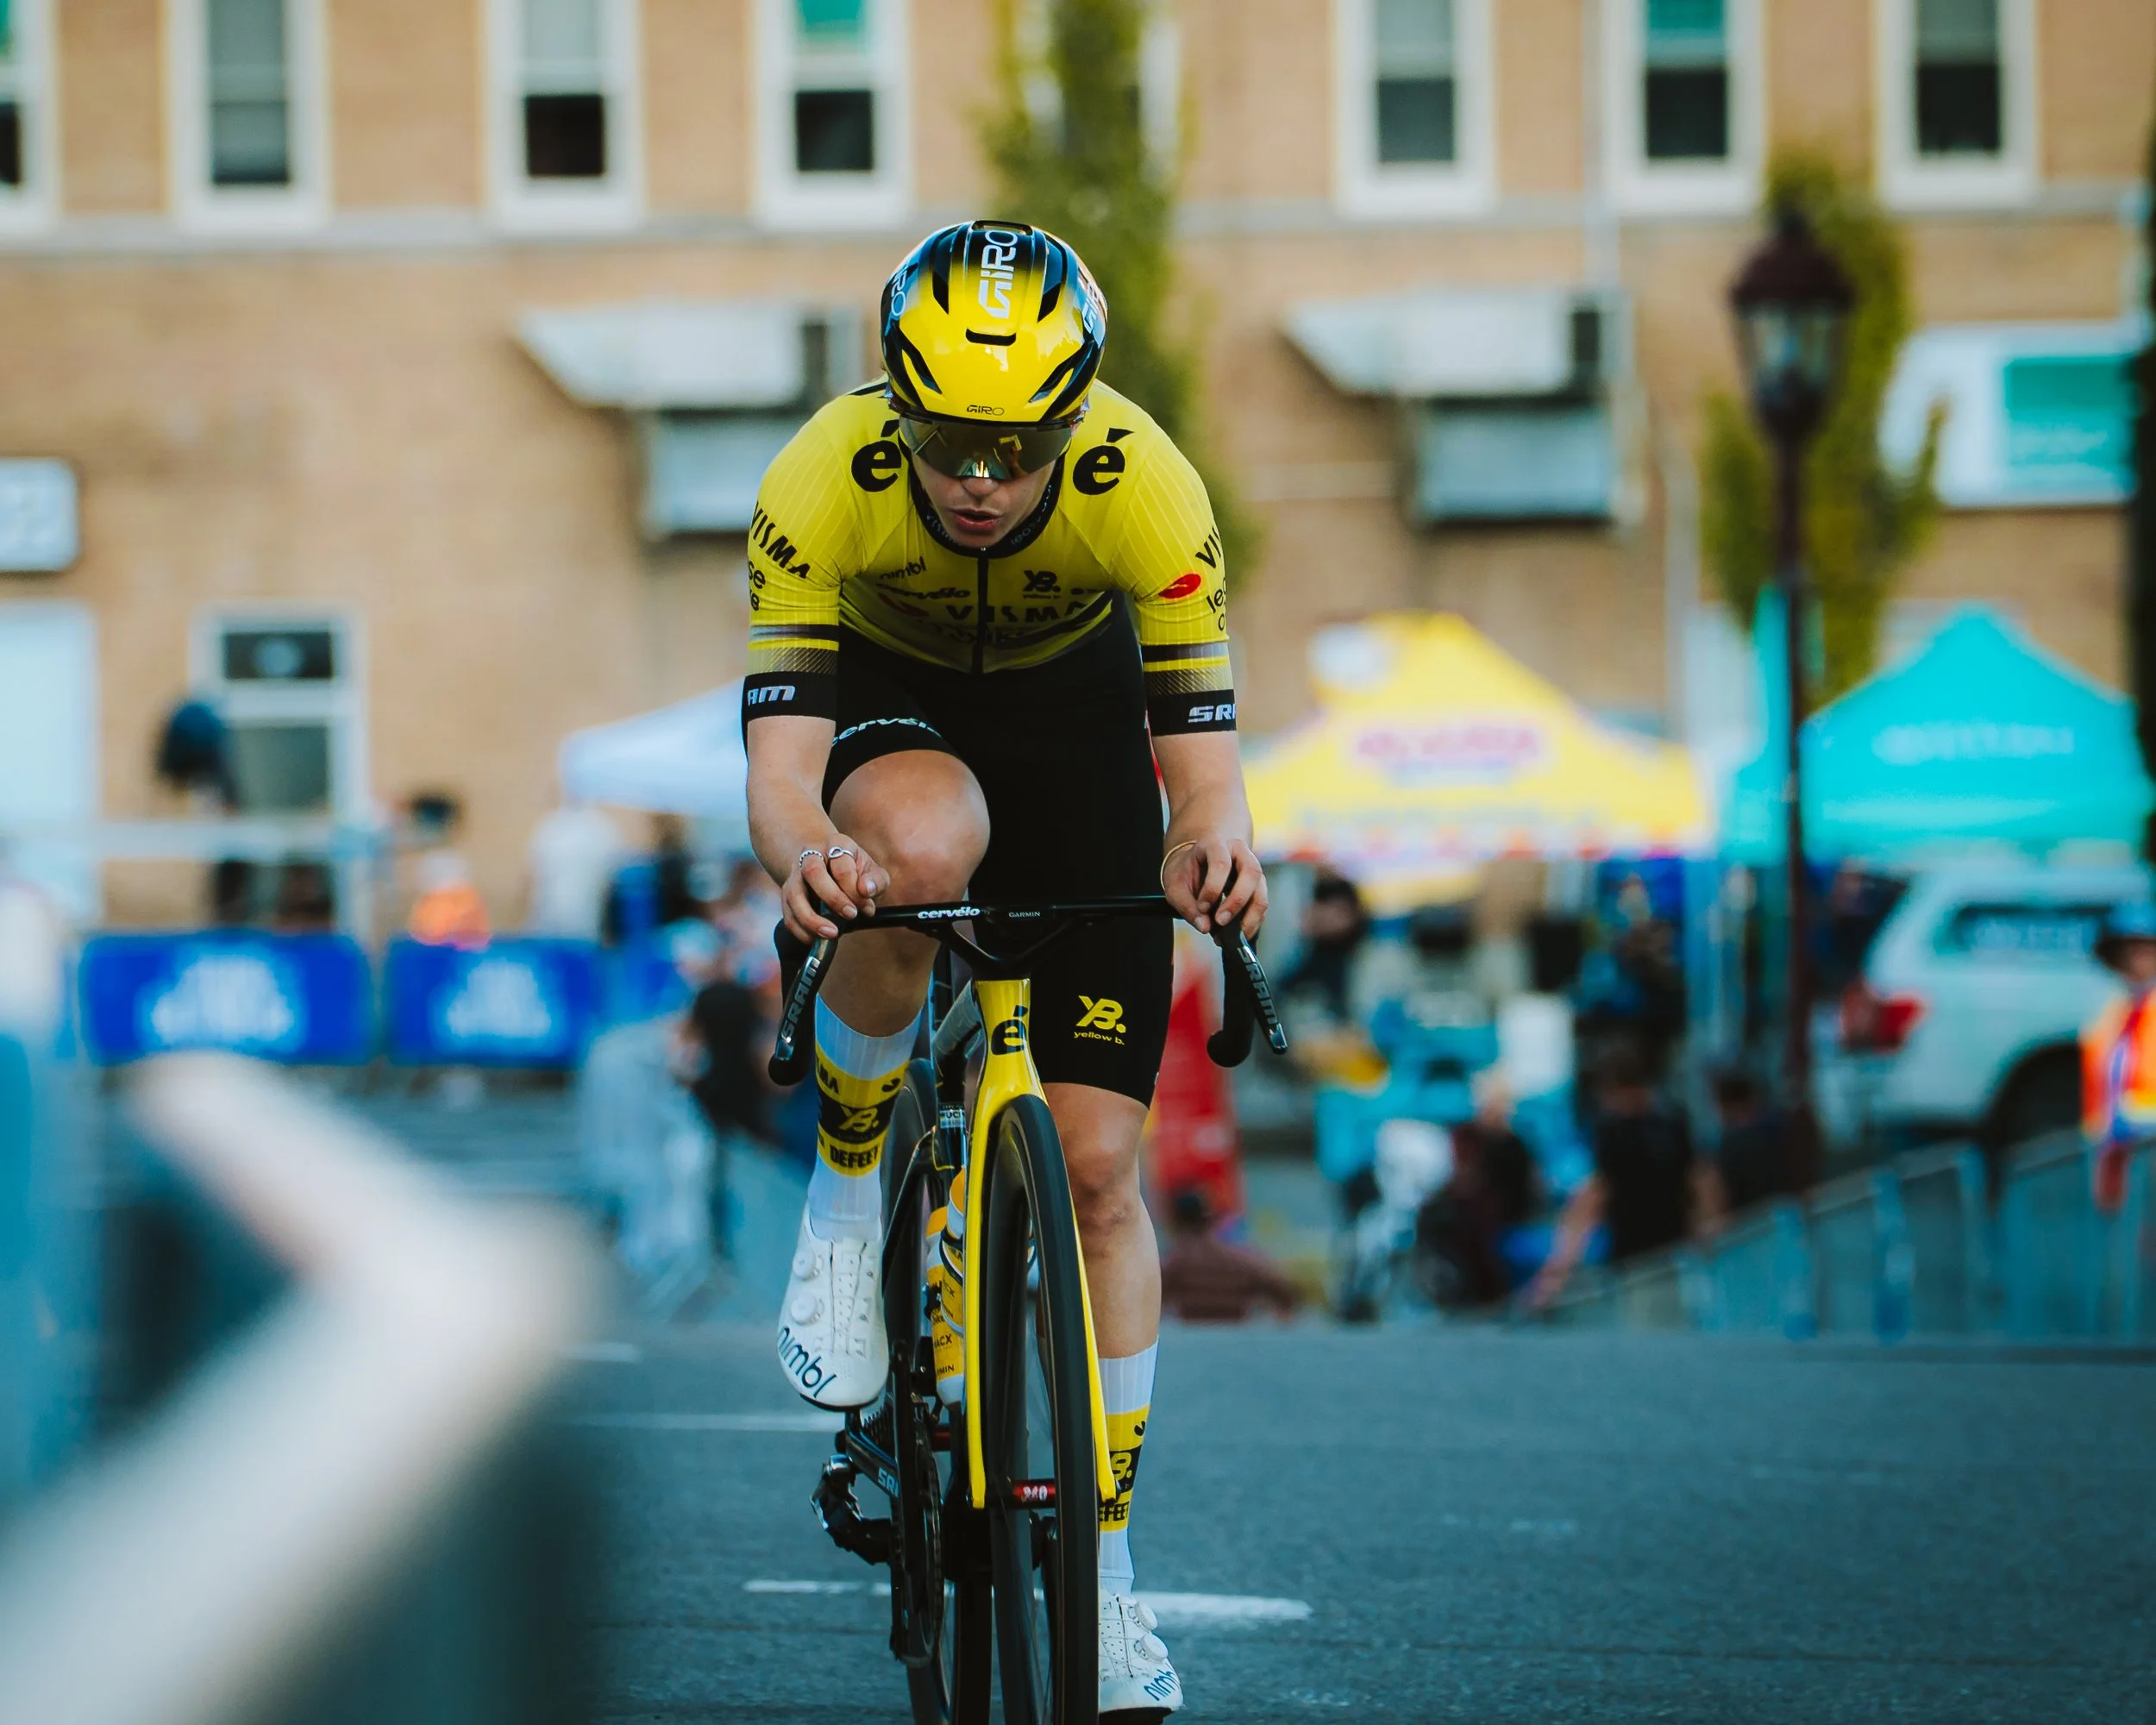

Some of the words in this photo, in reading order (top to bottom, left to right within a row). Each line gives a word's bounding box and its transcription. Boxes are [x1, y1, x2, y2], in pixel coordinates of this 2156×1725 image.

[1072, 427, 1135, 496] é
[749, 499, 811, 579] VISMA
[917, 906, 981, 919] cervélo
[1074, 1032, 1112, 1041] yellow
[777, 1326, 837, 1399] nimbl
